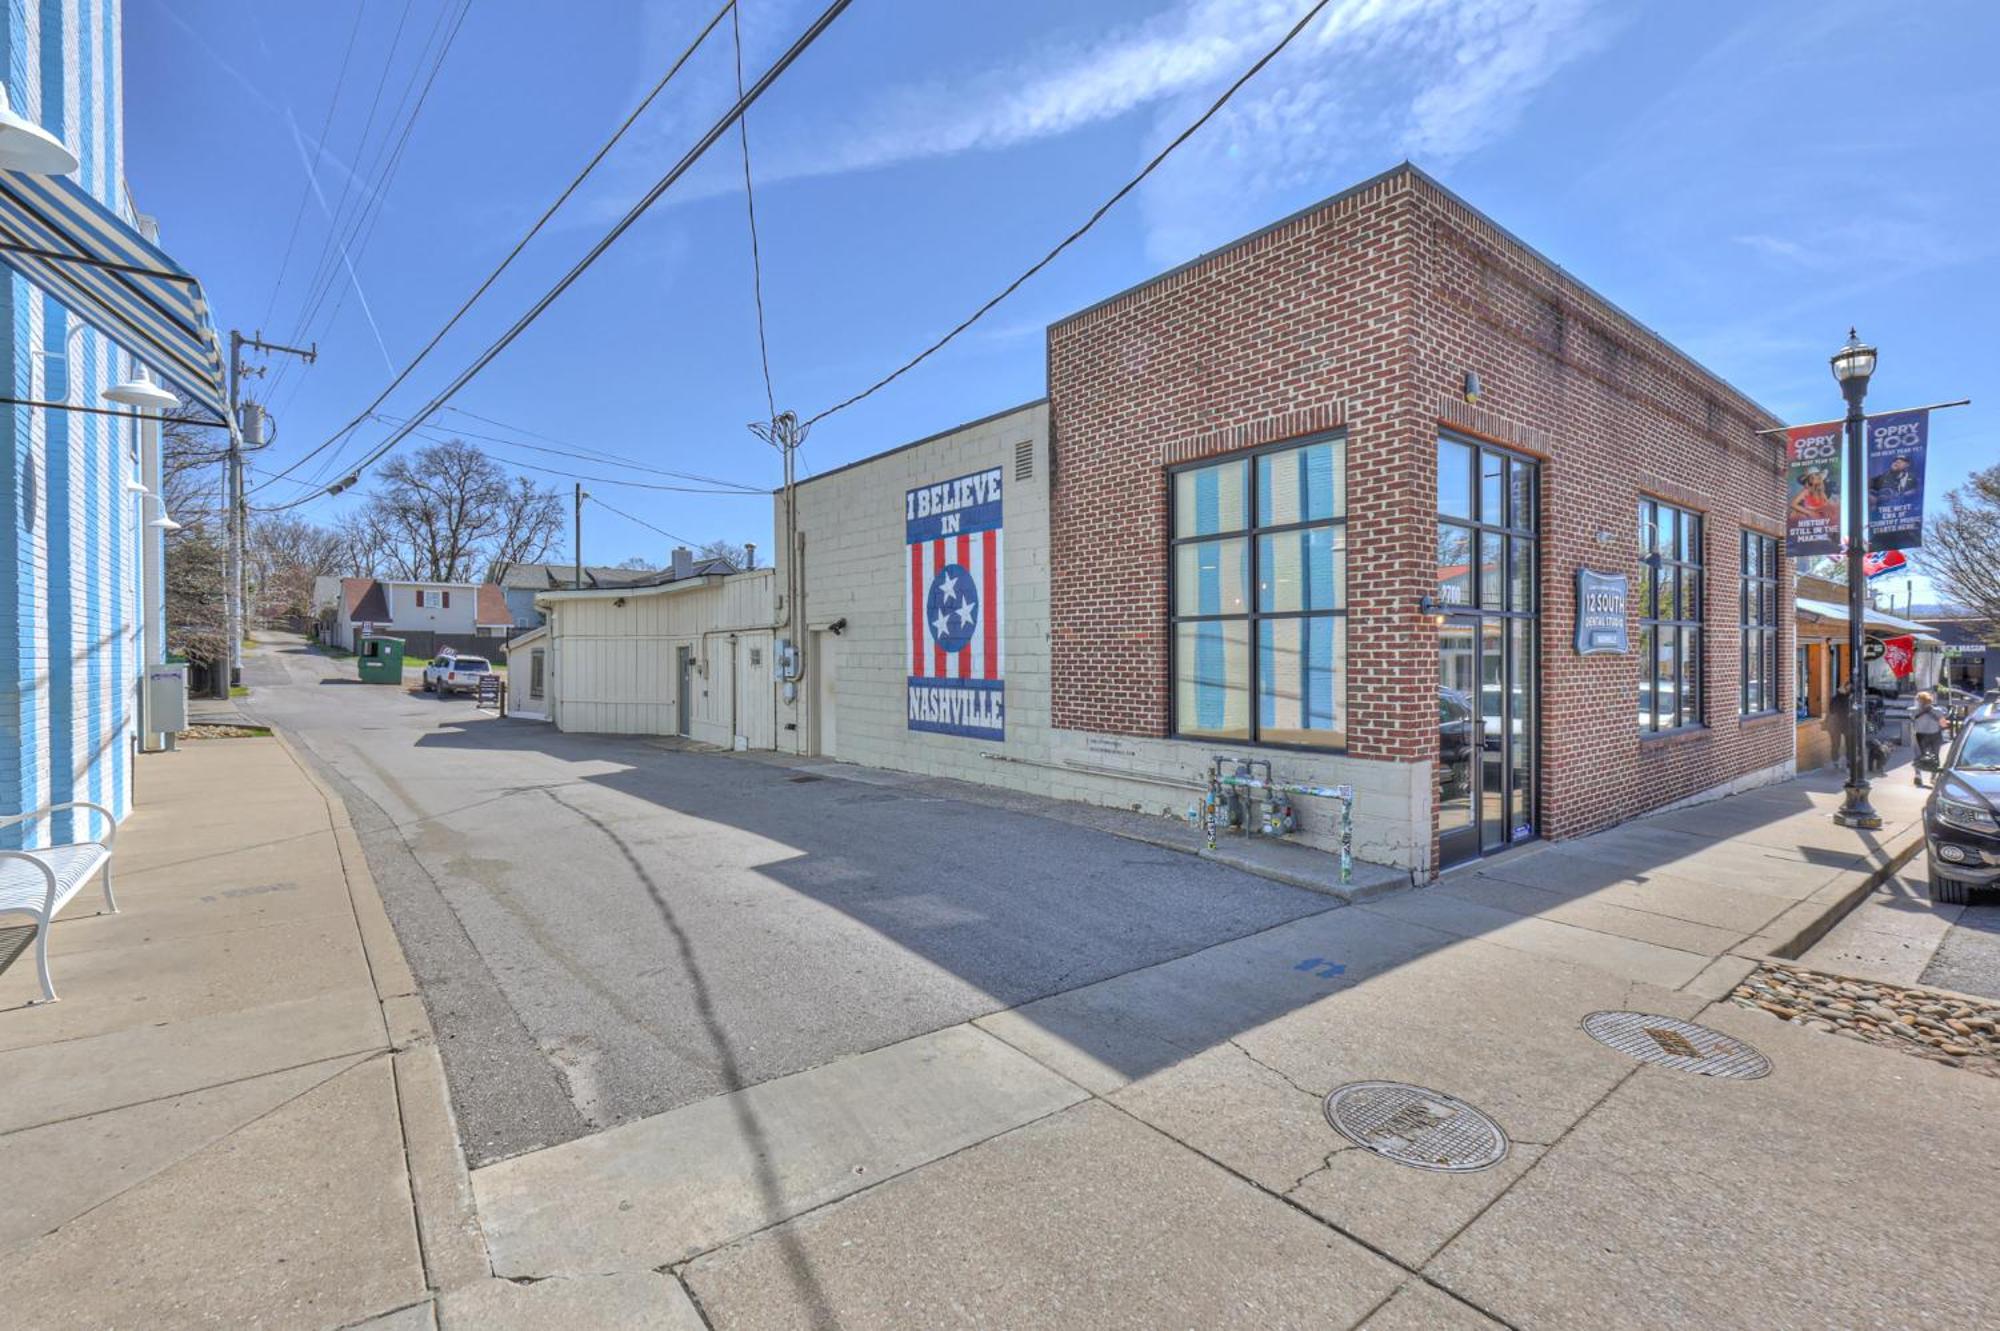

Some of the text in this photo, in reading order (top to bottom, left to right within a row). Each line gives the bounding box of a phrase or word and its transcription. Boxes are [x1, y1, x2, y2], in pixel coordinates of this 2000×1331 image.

[1874, 424, 1920, 437] OPRY
[1795, 434, 1835, 448] OPRY
[1874, 434, 1920, 450] 100
[1794, 445, 1836, 460] 100
[906, 469, 1001, 521] I BELIEVE
[941, 512, 960, 535] IN
[1798, 518, 1830, 528] HISTORY
[1790, 527, 1812, 536] STILL
[1586, 593, 1624, 615] 12 SOUTH
[909, 686, 1003, 730] NASHVILLE
